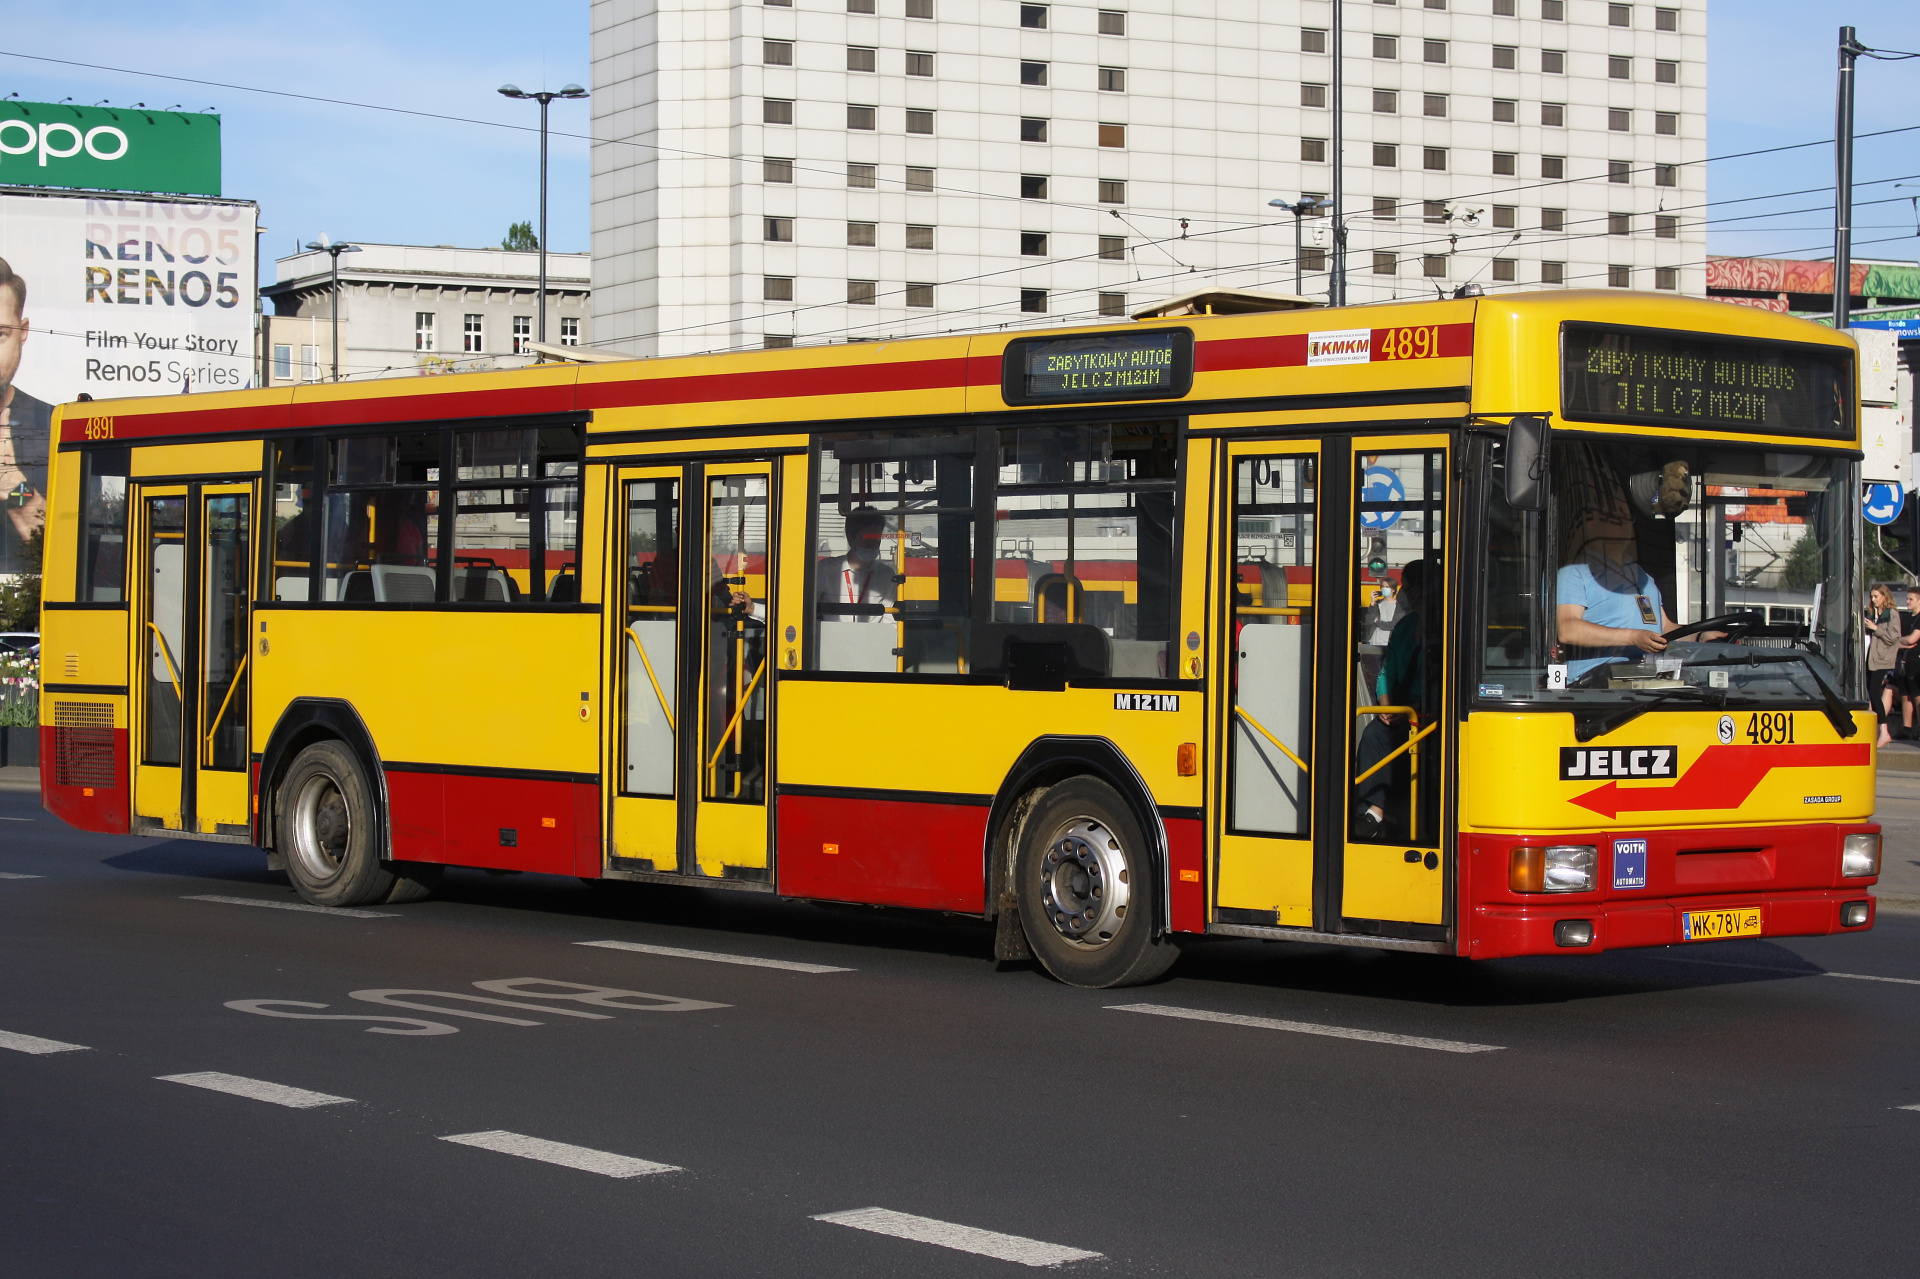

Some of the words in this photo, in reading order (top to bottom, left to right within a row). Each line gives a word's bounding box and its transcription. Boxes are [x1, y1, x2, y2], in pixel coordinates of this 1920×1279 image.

[0, 119, 129, 167] ppo
[85, 223, 240, 265] RENO5
[85, 266, 240, 309] RENO5
[85, 330, 127, 348] Film
[134, 332, 179, 350] Your
[185, 334, 238, 356] Story
[1321, 339, 1369, 356] KMKM
[1381, 325, 1440, 360] 4891
[85, 359, 162, 382] Reno5
[167, 361, 240, 385] Series
[1047, 351, 1128, 371] ZABYTKOWY
[1131, 349, 1173, 367] AUTOB
[1587, 348, 1706, 382] ZABYTKOWY
[1714, 361, 1795, 390] AUTOBUS
[1061, 371, 1112, 389] JELCZ
[1115, 368, 1161, 386] M121M
[1617, 382, 1703, 416] JELCZ
[1709, 390, 1767, 421] M121M
[84, 416, 115, 440] 4891
[1554, 670, 1562, 684] 8
[1746, 712, 1795, 745] 4891
[1568, 749, 1671, 777] JELCZ
[1804, 796, 1824, 804] ZASADA
[1616, 843, 1645, 854] VOITH
[1615, 877, 1644, 886] AUTOMATIC
[1692, 915, 1712, 936] WK
[1716, 912, 1741, 935] 78V
[222, 976, 735, 1036] BUS
